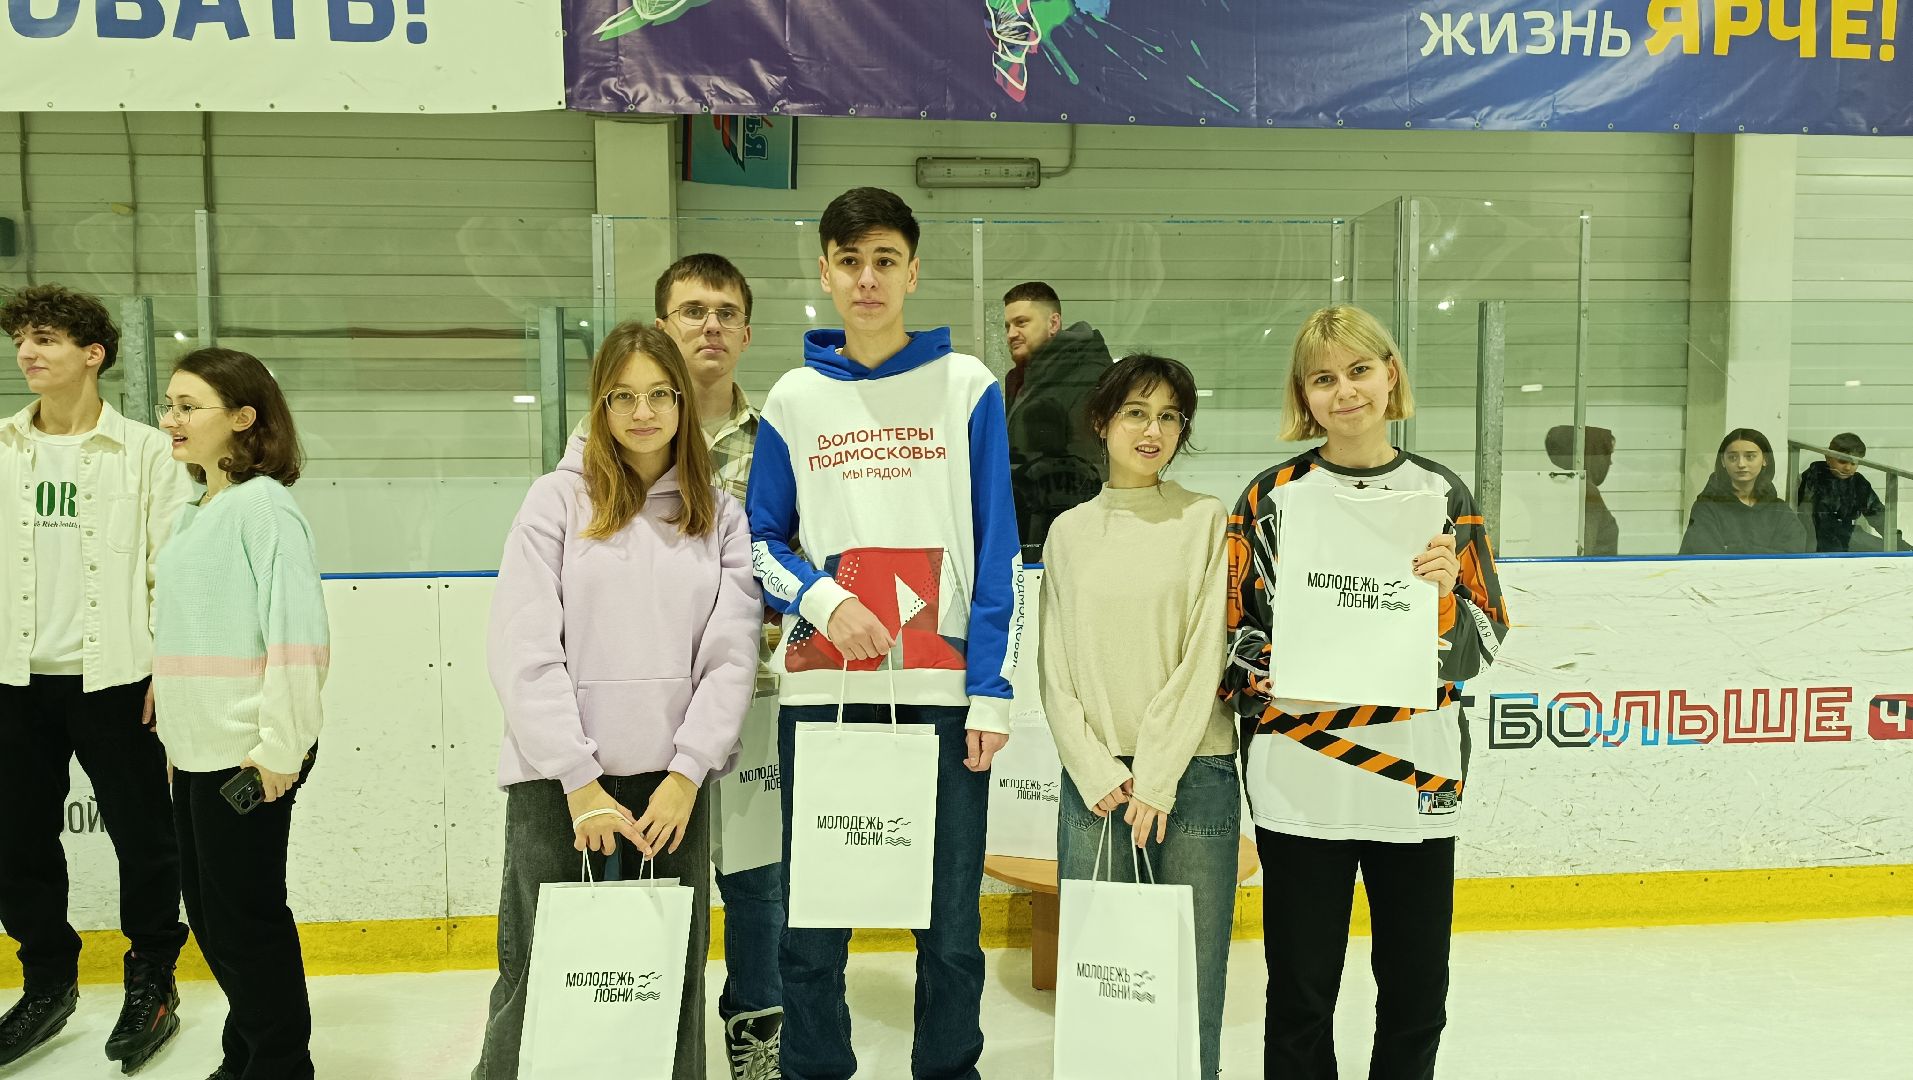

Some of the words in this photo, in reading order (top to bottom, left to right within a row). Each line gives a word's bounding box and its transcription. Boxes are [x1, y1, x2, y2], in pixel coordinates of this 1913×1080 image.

[1419, 10, 1632, 58] ЖИЗНЬ
[1645, 0, 1898, 62] ЯРЧЕ!
[817, 427, 934, 451] ВОЛОНТЕРЫ
[808, 445, 947, 471] ПОДМОСКОВЬЯ
[842, 469, 863, 480] МЫ
[866, 467, 912, 480] РЯДОМ
[1307, 571, 1379, 592] МОЛОДЕЖЬ
[1337, 591, 1379, 610] ЛОБНИ
[1489, 686, 1853, 749] БОЛЬШЕ
[999, 778, 1042, 791] МОЛОДЕЖЬ
[1016, 789, 1041, 801] ЛОБНИ
[817, 815, 884, 831] МОЛОДЕЖЬ
[845, 831, 883, 846] ЛОБНИ
[565, 971, 635, 988] МОЛОДЕЖЬ
[1077, 962, 1131, 983] МОЛОДЕЖЬ
[593, 987, 633, 1003] ЛОБНИ
[1098, 981, 1131, 1001] ЛОБНИ
